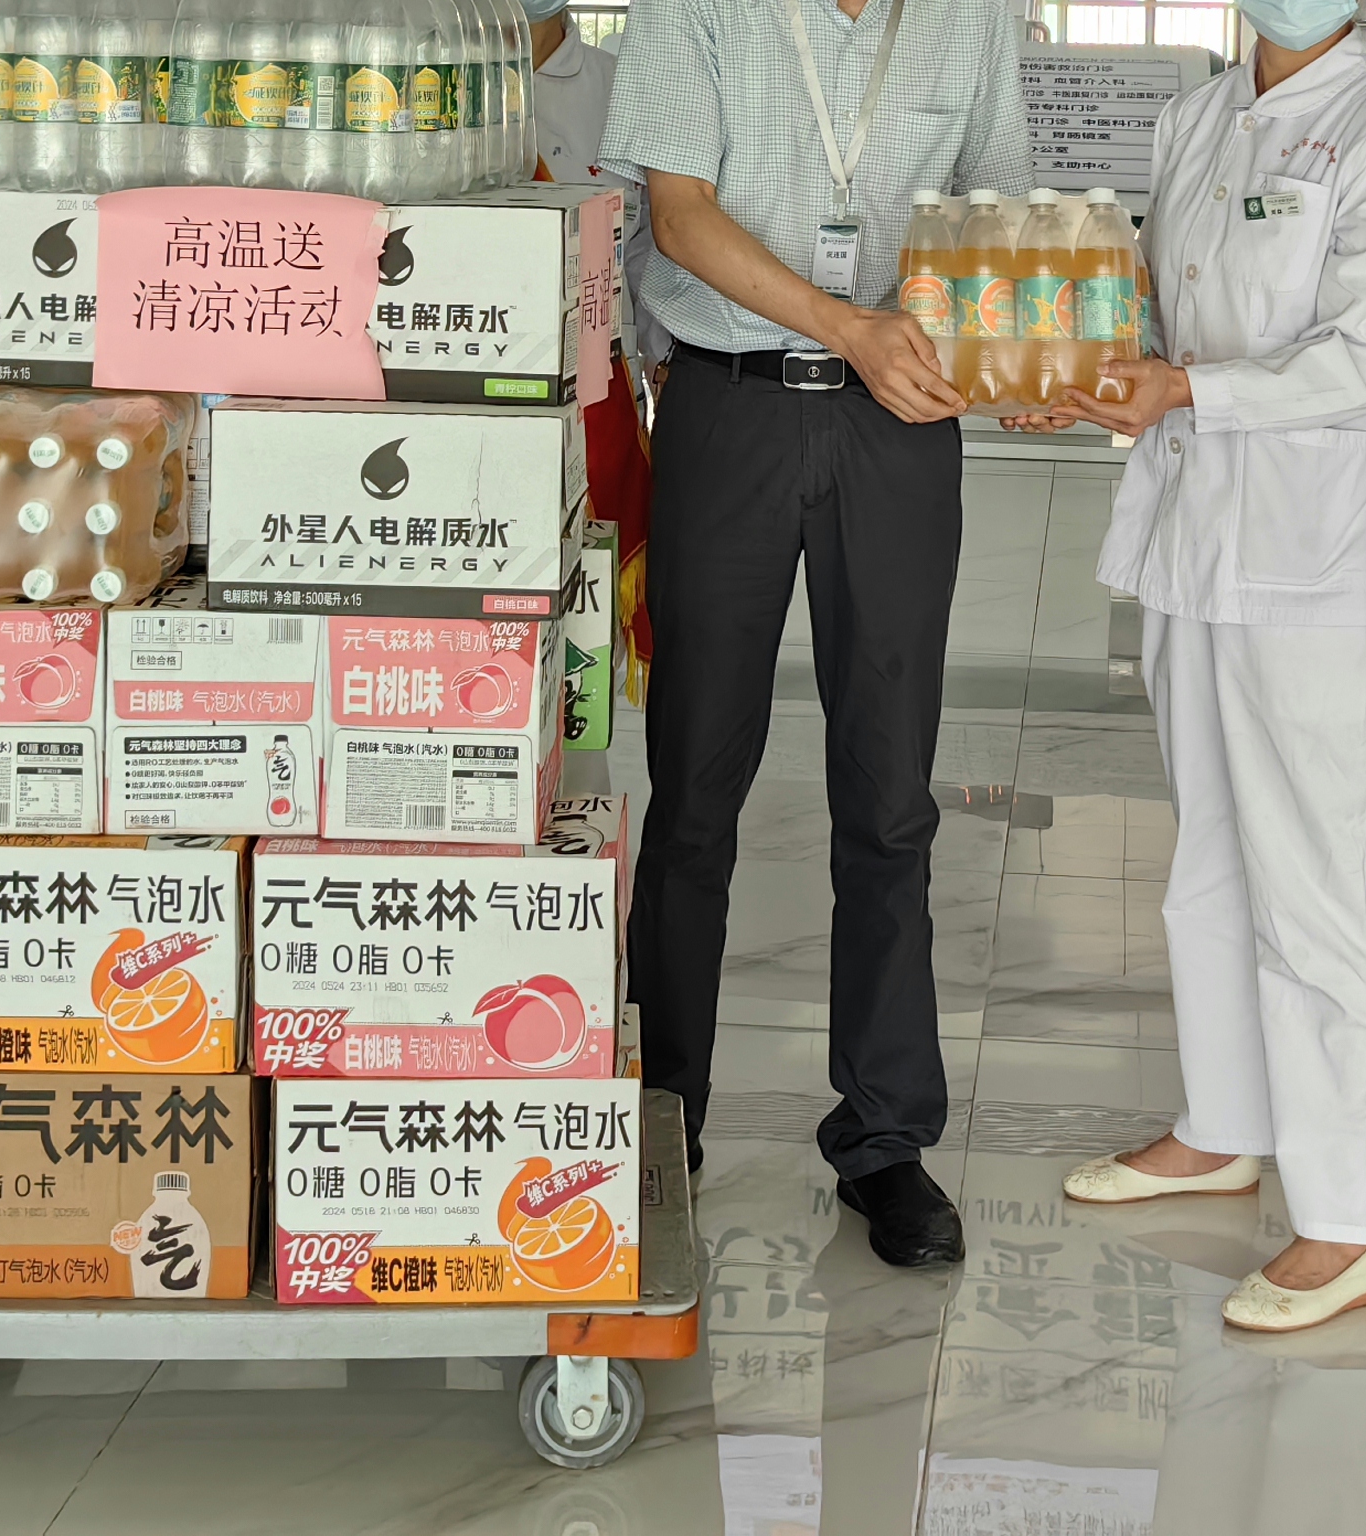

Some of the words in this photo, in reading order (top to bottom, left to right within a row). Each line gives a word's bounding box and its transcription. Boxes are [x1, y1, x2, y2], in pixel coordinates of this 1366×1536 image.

[163, 215, 326, 271] 高温送
[132, 278, 343, 338] 清凉活动
[261, 512, 509, 549] 外星人电解质水
[260, 554, 509, 573] ALIENERGY
[222, 589, 269, 605] 电解质饮料
[0, 621, 51, 644] 气泡水
[51, 612, 93, 627] 100%
[53, 626, 85, 642] 中奖
[489, 621, 530, 637] 100%
[341, 628, 435, 652] 元气森林
[438, 629, 489, 653] 气泡水
[491, 636, 523, 652] 中奖
[136, 655, 176, 666] 检验合格
[129, 689, 184, 713] 白桃味
[192, 690, 301, 714] 气泡水(汽水)
[342, 665, 445, 717] 白桃味
[63, 743, 80, 754] 0卡
[129, 738, 242, 752] 元气森林坚持四大理念
[346, 741, 380, 754] 白桃味
[498, 748, 515, 758] 0卡
[130, 814, 170, 825] 检验合格
[107, 873, 226, 924] 气泡水
[261, 876, 479, 932] 元气森林
[485, 880, 605, 932] 气泡水
[24, 937, 77, 970] 0卡
[260, 941, 318, 975] 0糖
[332, 943, 388, 976] 0脂
[402, 945, 455, 977] 0卡
[257, 1009, 343, 1041] 100%
[38, 1027, 98, 1066] 气泡水(汽水)
[263, 1042, 327, 1073] 中奖
[344, 1033, 403, 1071] 白桃味
[288, 1099, 506, 1154] 元气森林
[514, 1101, 632, 1152] 气泡水
[14, 1173, 57, 1199] 0卡
[287, 1165, 345, 1199] 0糖
[359, 1165, 416, 1199] 0脂
[429, 1165, 483, 1198] 0卡
[140, 1214, 202, 1291] 气
[283, 1234, 372, 1266] 100%
[289, 1265, 356, 1298] 中奖
[371, 1257, 438, 1294] 维C橙味
[444, 1255, 504, 1294] 气泡水(汽水)
